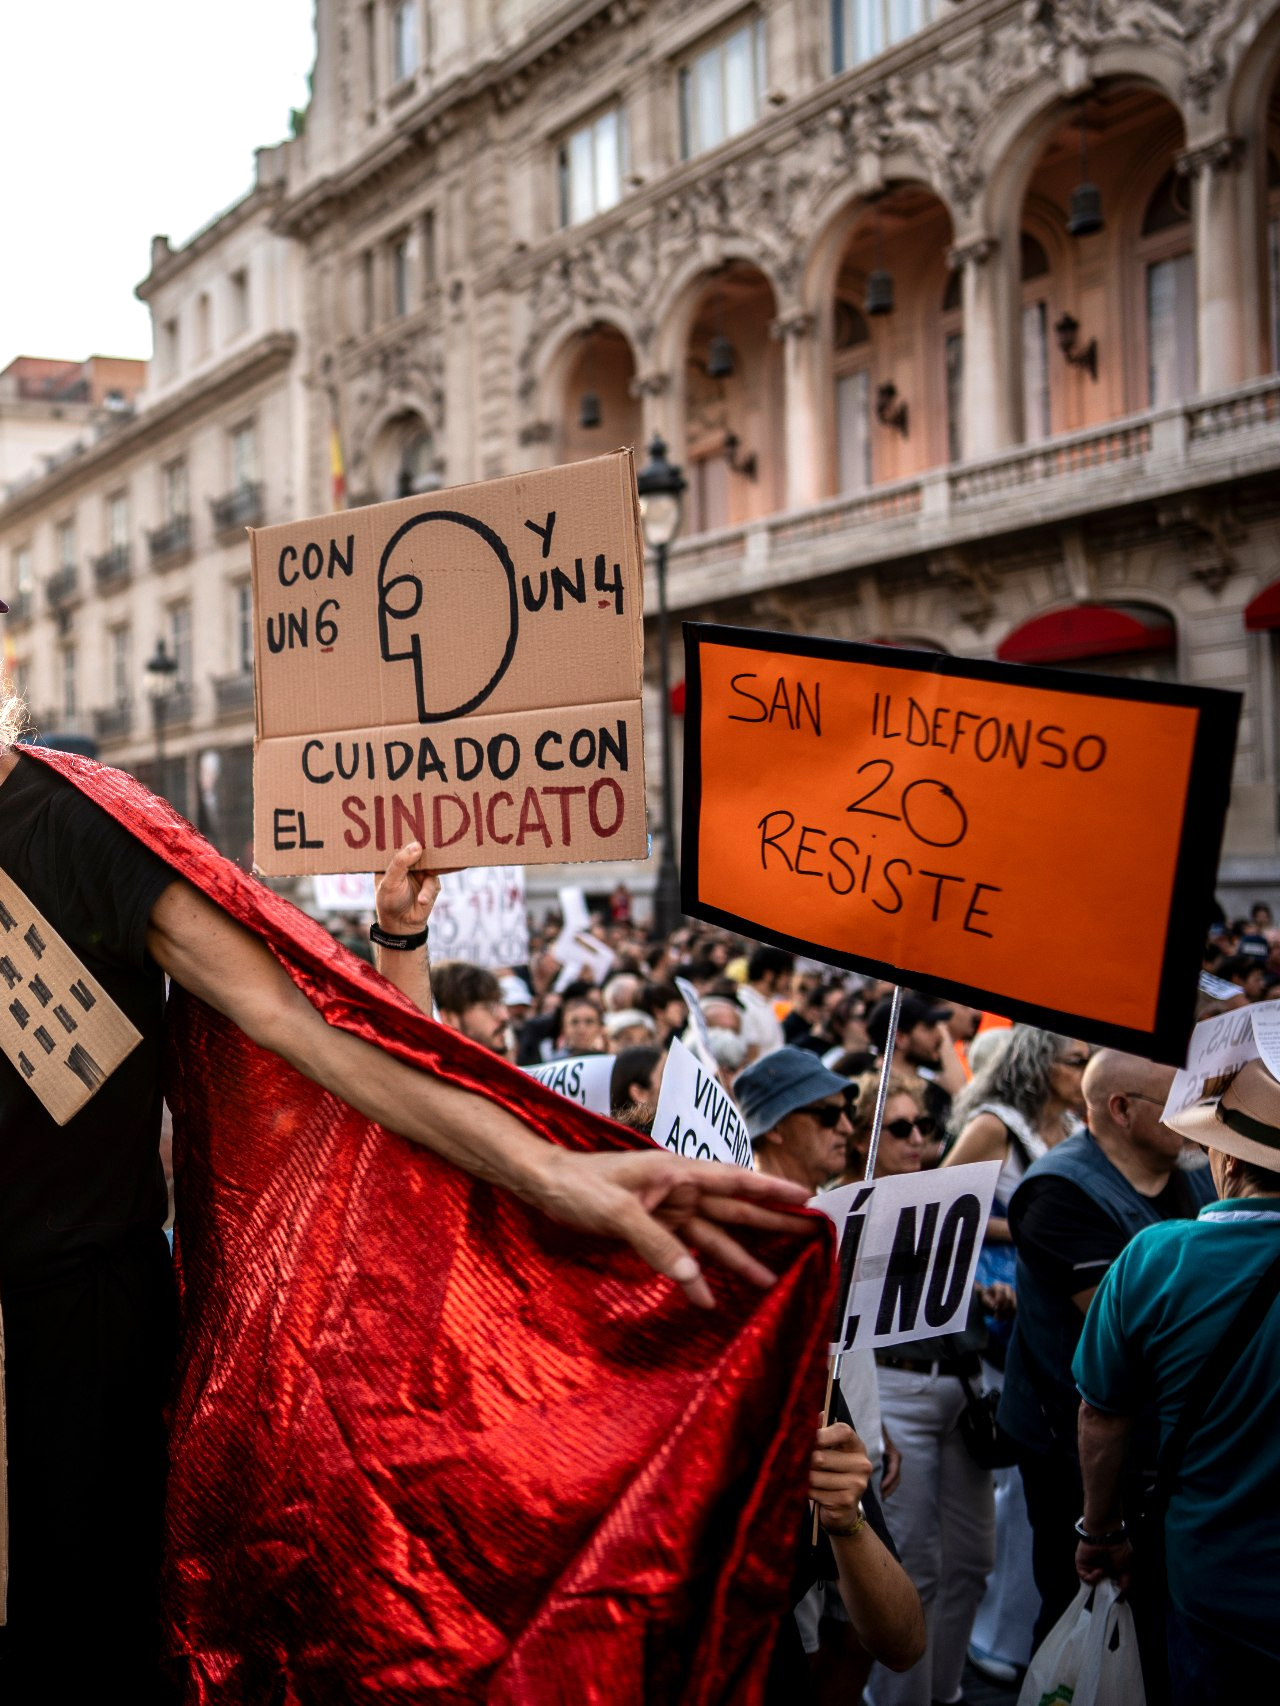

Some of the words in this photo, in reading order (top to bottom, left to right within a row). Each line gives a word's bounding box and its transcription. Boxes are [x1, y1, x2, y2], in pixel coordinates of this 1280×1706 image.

[278, 534, 355, 587] CON
[524, 511, 556, 558] Y
[521, 558, 587, 612] UN
[594, 553, 624, 615] 4
[267, 606, 308, 654] UN
[315, 598, 341, 647] 6
[301, 732, 521, 784] CUIDADO
[534, 719, 629, 773] CON
[728, 673, 822, 737] SAN
[872, 692, 1108, 772] ILDEFONSO
[273, 807, 325, 851] EL
[341, 777, 625, 852] SINDICATO
[846, 759, 968, 848] 20
[833, 1186, 876, 1350] Í,
[874, 1193, 981, 1336] NO
